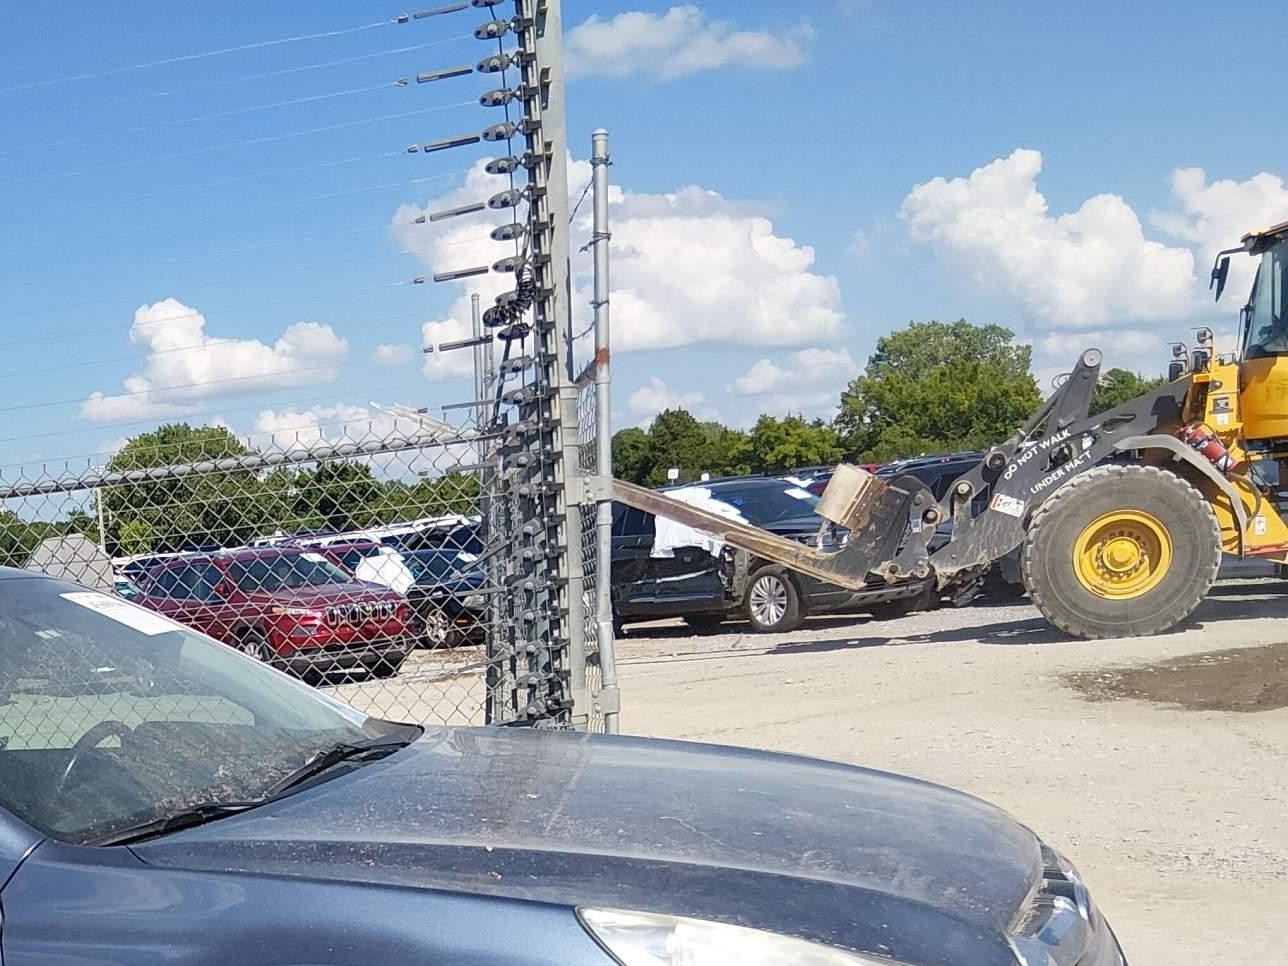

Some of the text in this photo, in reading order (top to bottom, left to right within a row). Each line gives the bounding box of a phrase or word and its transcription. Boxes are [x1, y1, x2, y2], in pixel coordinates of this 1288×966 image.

[1004, 429, 1072, 481] DO NOT WALK
[1030, 469, 1066, 494] UNDER
